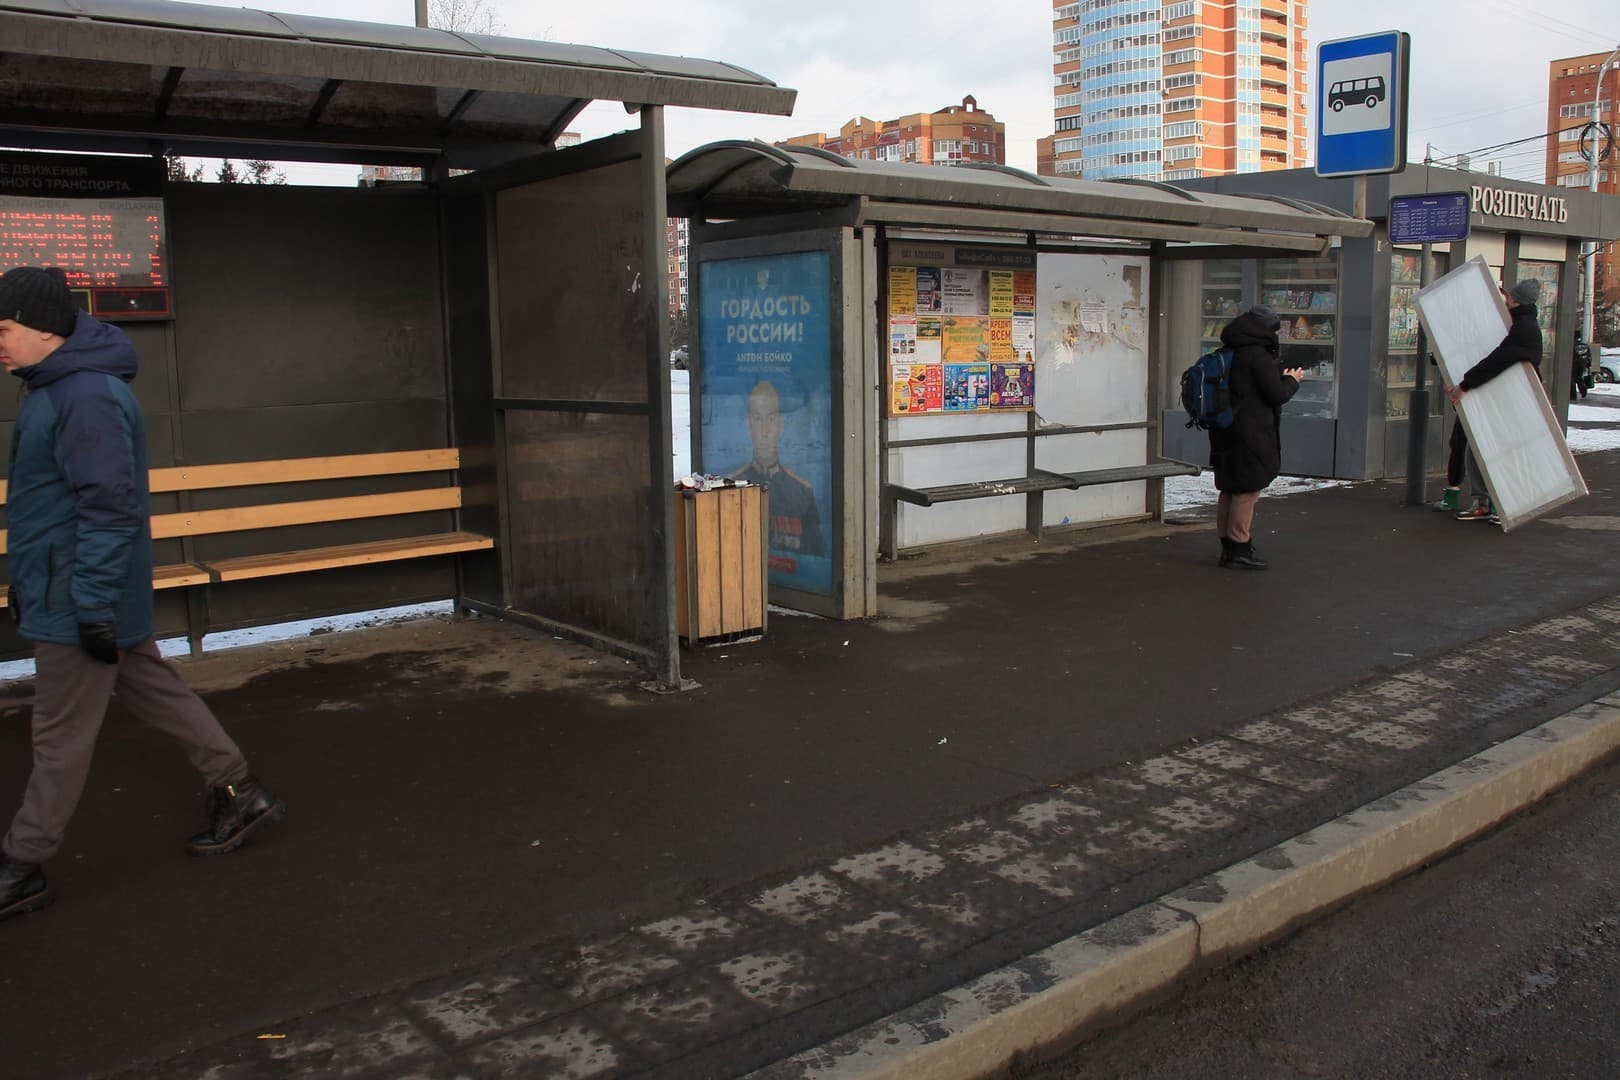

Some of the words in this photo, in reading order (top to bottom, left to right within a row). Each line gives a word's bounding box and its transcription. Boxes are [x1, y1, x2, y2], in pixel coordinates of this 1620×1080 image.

[12, 164, 88, 177] ДВИЖЕНИЯ
[45, 178, 131, 192] ТРАНСПОРТА
[1470, 185, 1568, 223] РОЗПЕЧАТЬ
[720, 295, 811, 320] ГОРДОСТЬ
[990, 320, 1011, 329] КРЕДИТ
[727, 321, 804, 344] РОССИИ!
[991, 329, 1011, 341] ВСЕМ
[736, 352, 763, 363] АНТОН
[764, 350, 793, 363] БОЙКО
